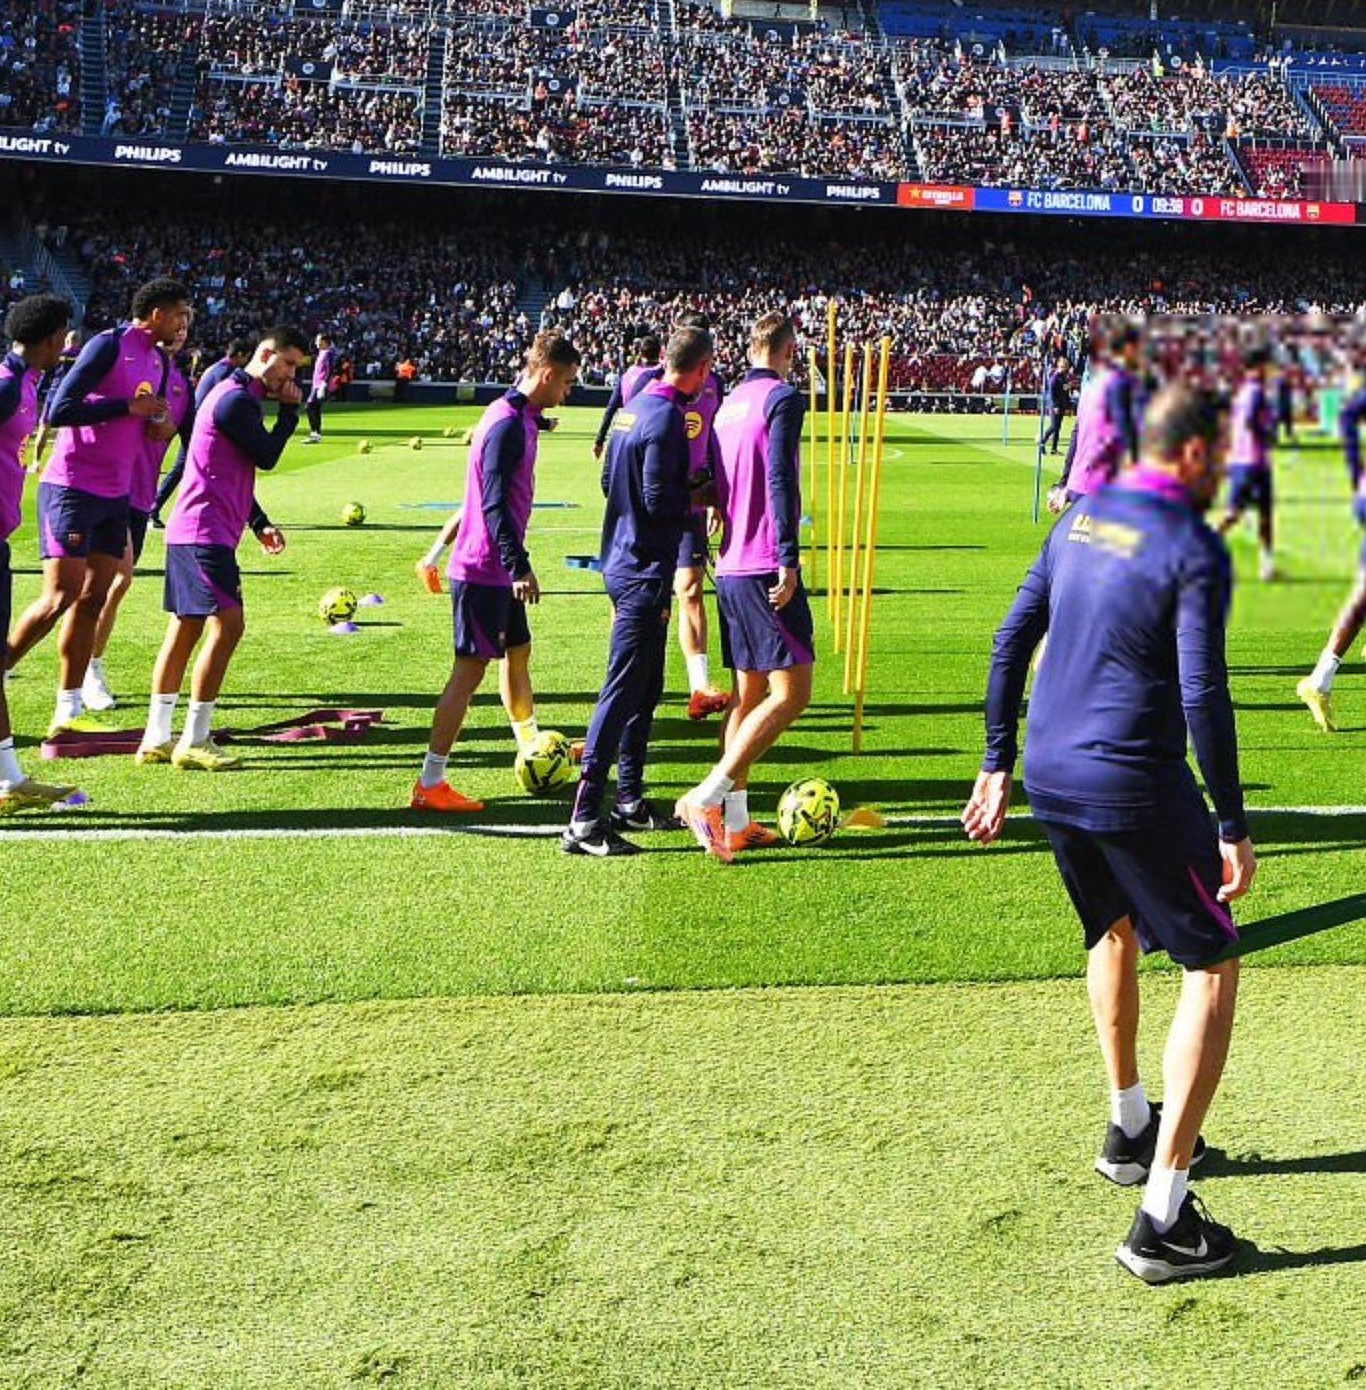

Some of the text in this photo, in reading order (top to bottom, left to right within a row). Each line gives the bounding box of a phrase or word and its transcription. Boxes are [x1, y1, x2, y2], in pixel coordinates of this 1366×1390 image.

[53, 140, 70, 155] tv
[114, 144, 182, 163] PHILIPS
[225, 151, 328, 172] AMBILIGHT tv
[369, 159, 431, 178] PHILIPS
[471, 166, 568, 185] AMBILIGHT tv
[605, 173, 663, 189] PHILIPS
[700, 178, 791, 196] AMBILIGHT tv
[825, 185, 881, 201] PHILIPS
[1026, 191, 1111, 210] FC BARCELONA
[1132, 196, 1144, 212] 0
[1191, 198, 1203, 216] 0
[1220, 200, 1300, 219] FC BARCELONA
